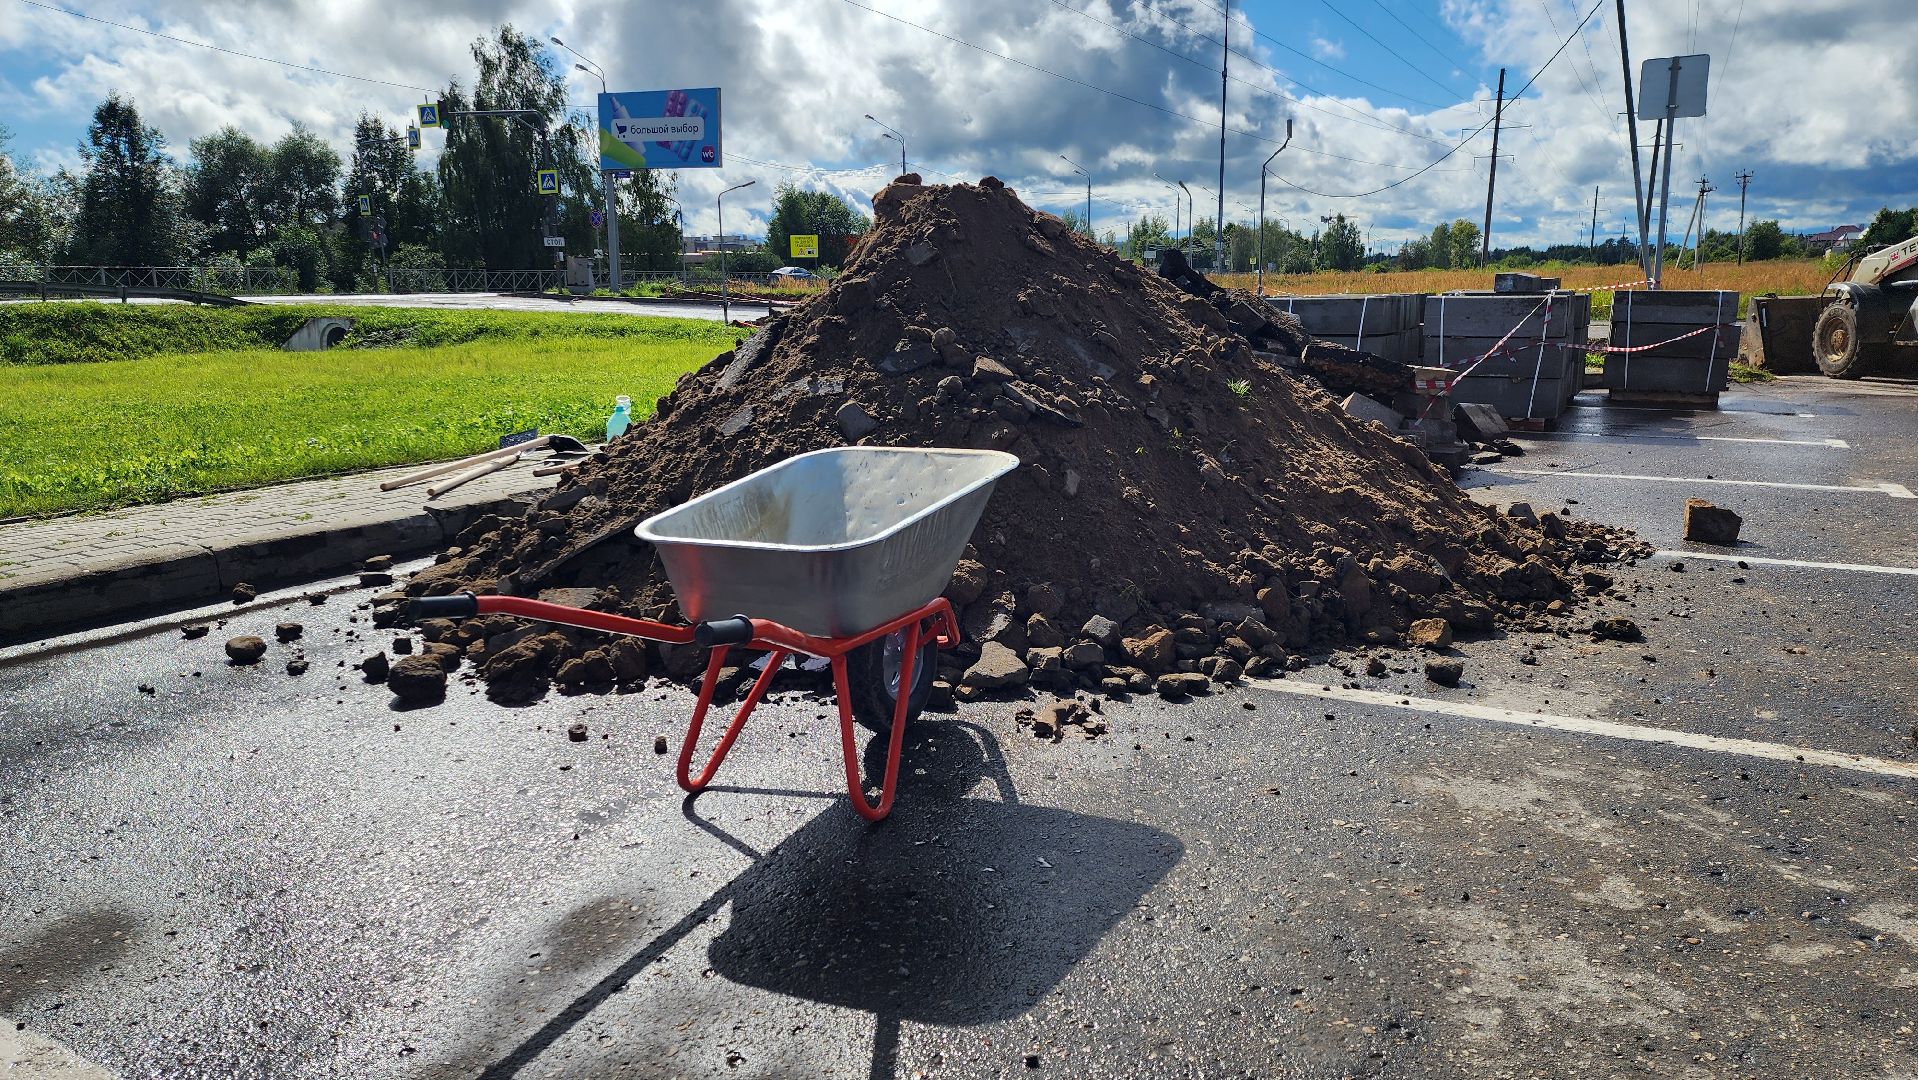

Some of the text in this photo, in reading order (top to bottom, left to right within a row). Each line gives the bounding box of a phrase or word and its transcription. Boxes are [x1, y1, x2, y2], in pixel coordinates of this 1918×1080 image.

[630, 123, 699, 134] большой выбор
[1901, 242, 1918, 255] TE
